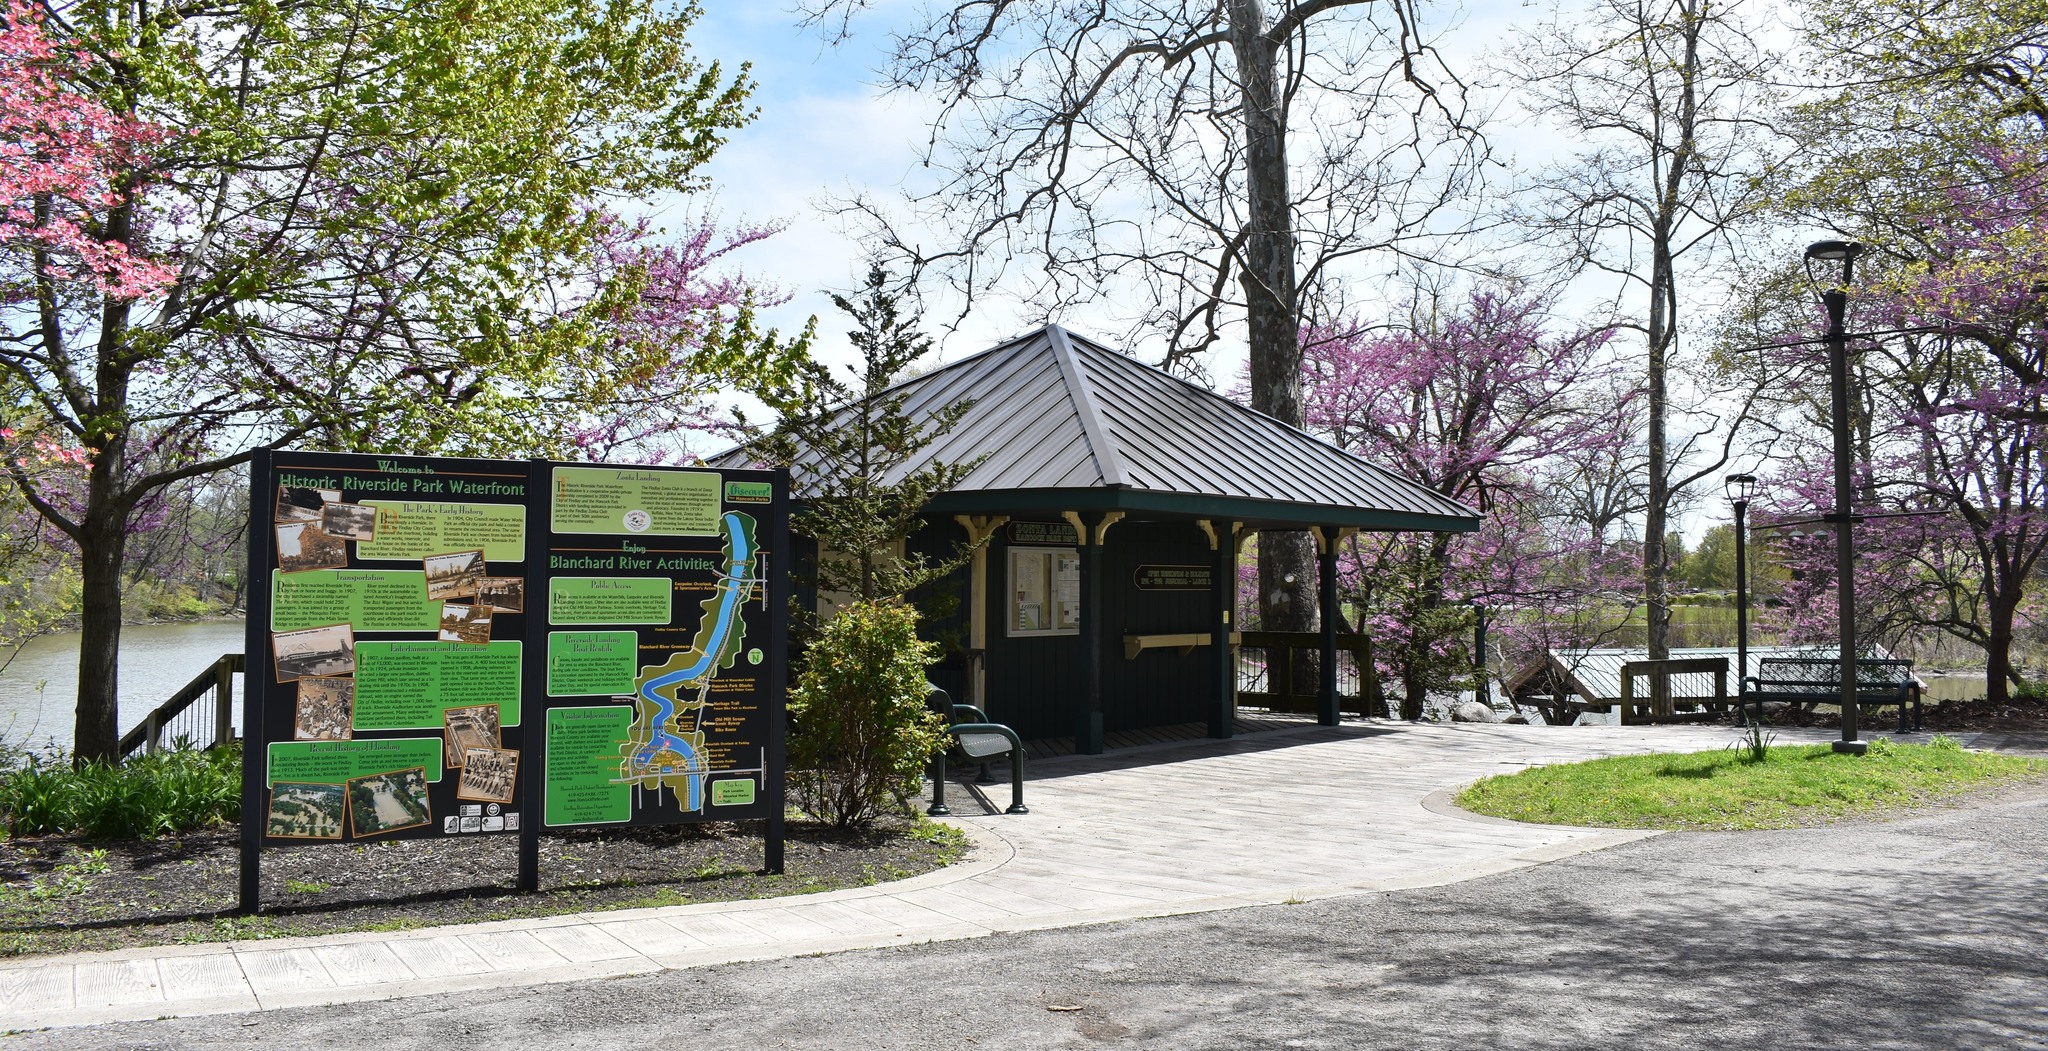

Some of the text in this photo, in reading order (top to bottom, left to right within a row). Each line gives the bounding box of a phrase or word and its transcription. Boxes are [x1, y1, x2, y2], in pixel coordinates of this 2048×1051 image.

[377, 460, 434, 474] Welcome to
[616, 471, 661, 482] Zonta Landing
[280, 474, 525, 495] Historic Riverside Park Waterfront
[403, 504, 483, 515] The Park's Early History
[1016, 523, 1077, 535] ZONTA LAND
[622, 540, 646, 554] Enjoy
[550, 556, 614, 569] Blanchard
[619, 557, 652, 570] River
[656, 557, 715, 570] Activities
[336, 571, 385, 581] Transportation
[591, 580, 632, 589] Public Access
[390, 643, 487, 652] Entertainment and Recreation
[335, 742, 360, 752] History
